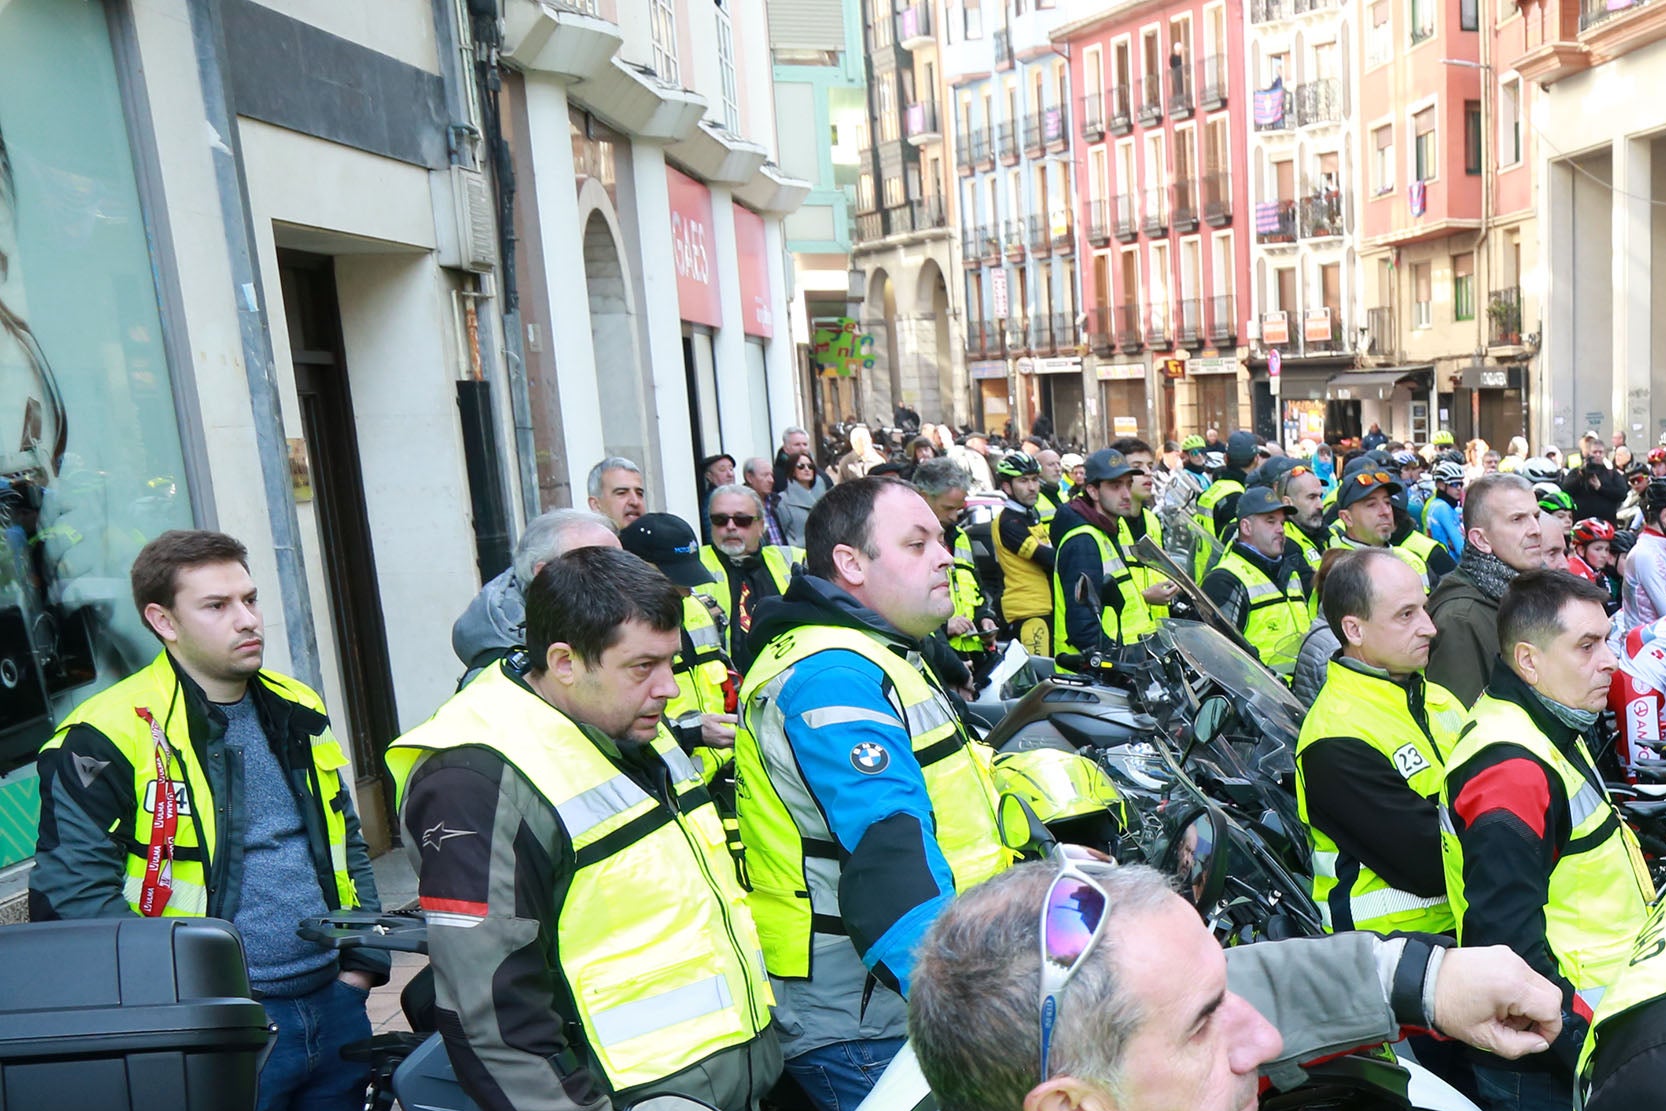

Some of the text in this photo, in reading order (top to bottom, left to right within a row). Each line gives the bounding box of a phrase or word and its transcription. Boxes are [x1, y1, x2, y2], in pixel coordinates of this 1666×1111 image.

[672, 211, 709, 285] GAES
[853, 743, 883, 755] BMW
[1636, 719, 1651, 760] AMO
[1399, 747, 1423, 772] 23
